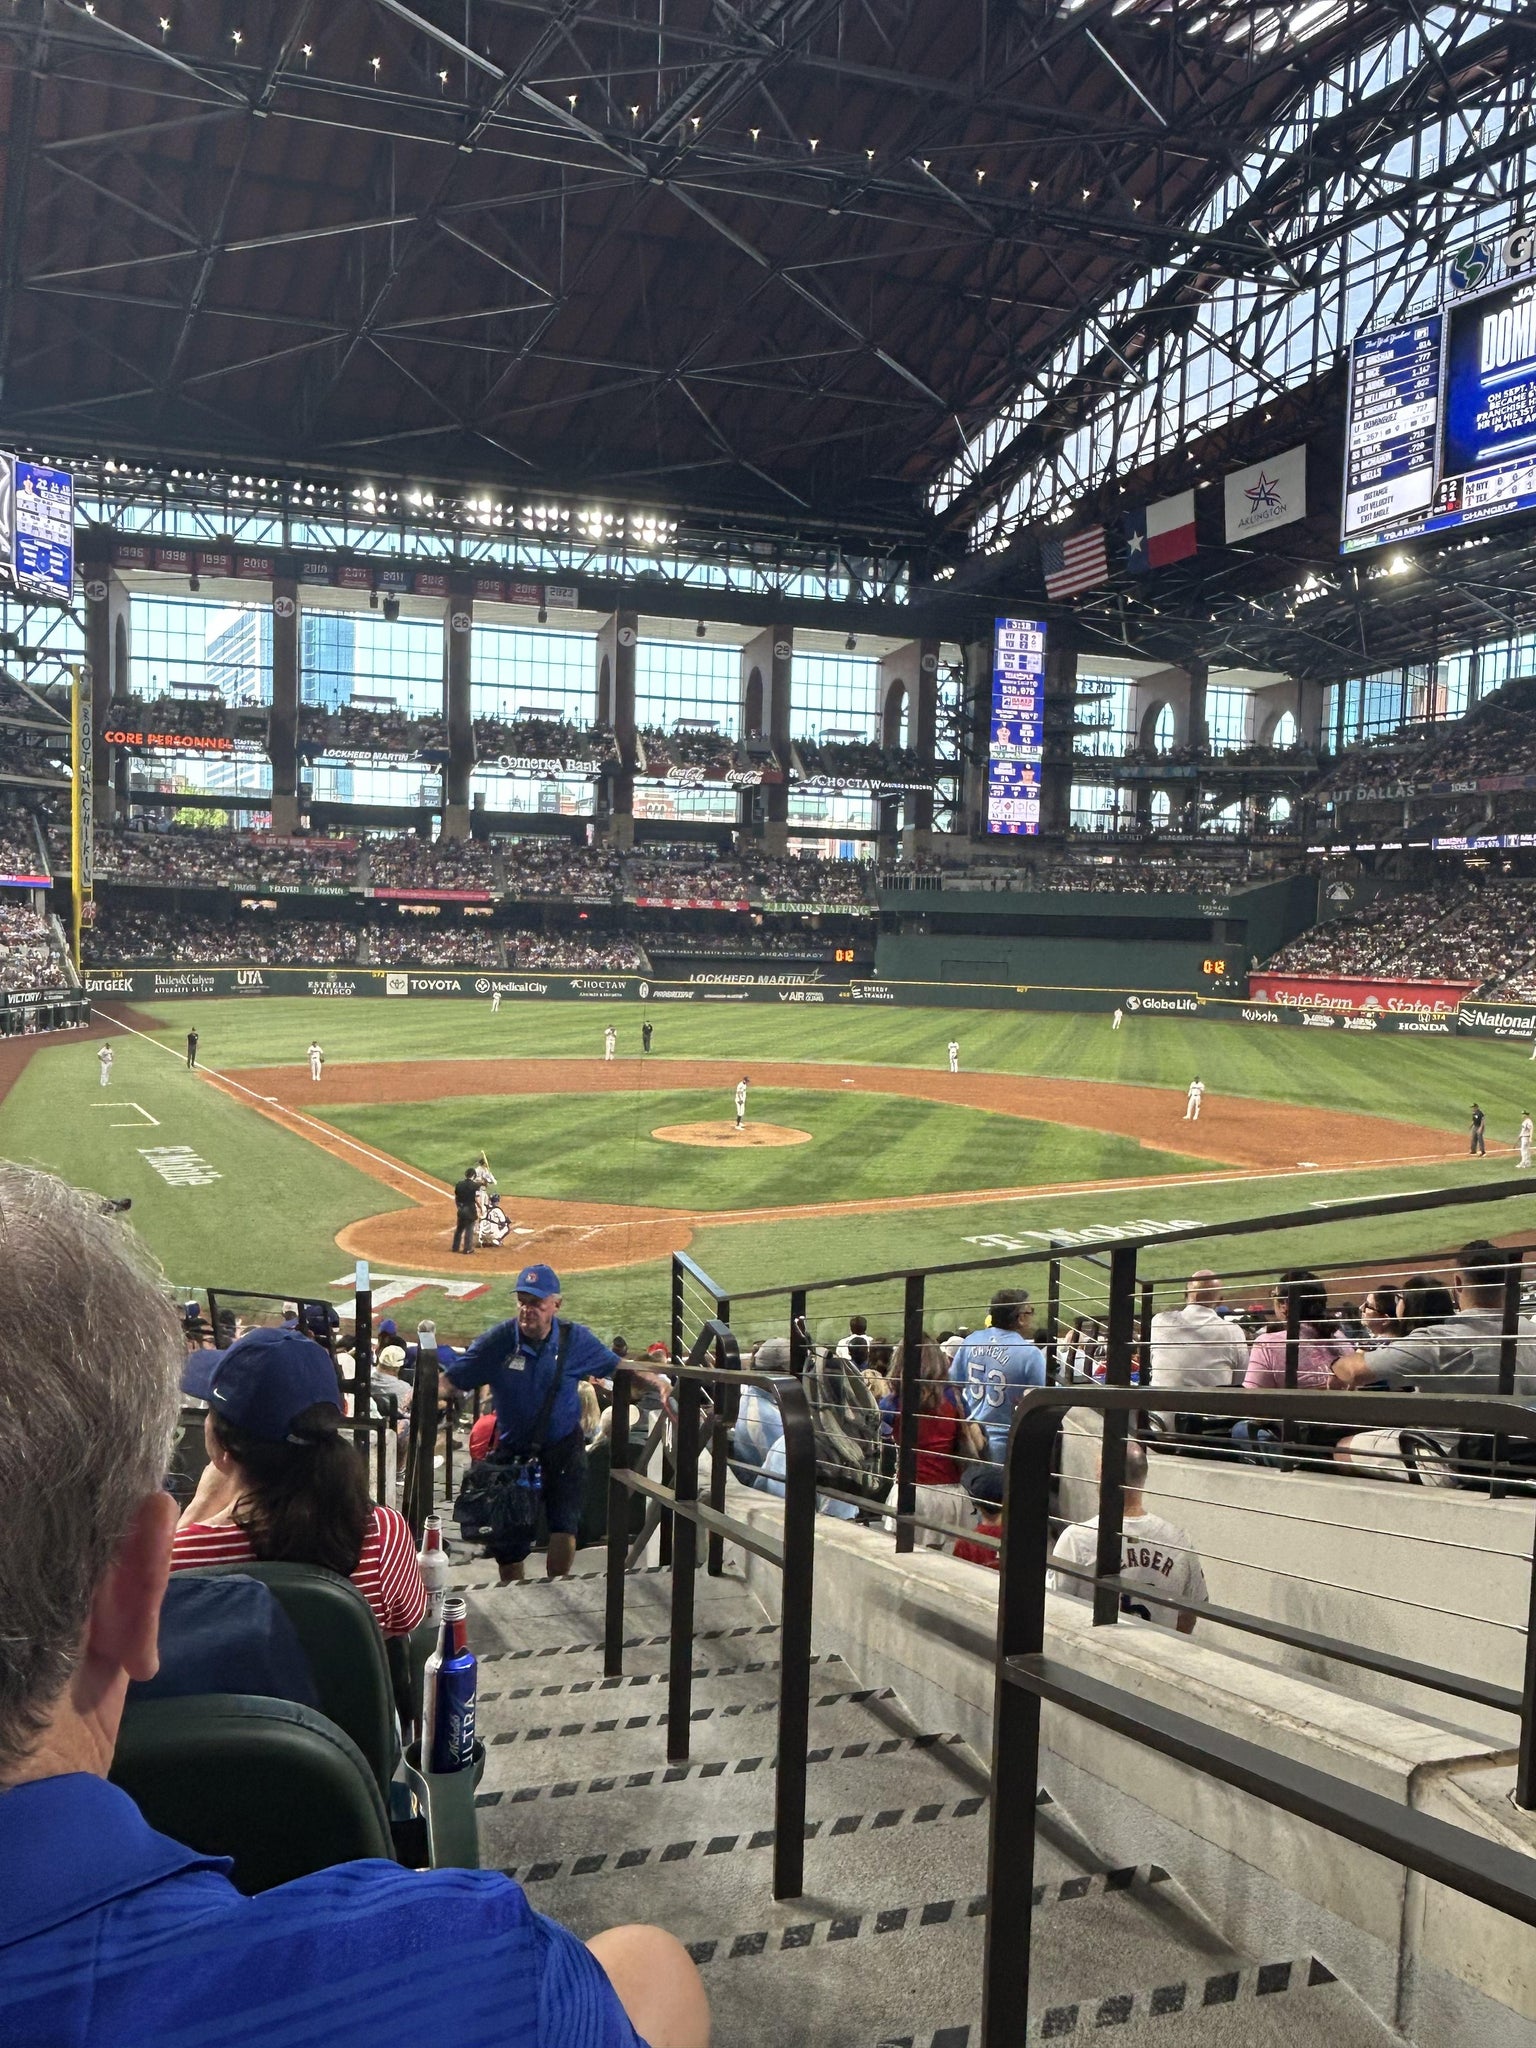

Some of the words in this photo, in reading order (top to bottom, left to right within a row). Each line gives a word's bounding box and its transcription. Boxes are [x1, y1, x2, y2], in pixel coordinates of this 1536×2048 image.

[1487, 392, 1501, 403] ON
[1476, 402, 1526, 422] FRANCHISE
[1494, 418, 1523, 433] PLATE
[1449, 481, 1457, 491] 2
[1462, 501, 1518, 521] CHANGEUP
[276, 602, 292, 614] 34
[623, 631, 631, 642] 7
[105, 731, 143, 745] CORE
[148, 733, 233, 750] PERSONNEL
[323, 748, 371, 759] LOCKHEED
[373, 751, 408, 761] MARTIN
[566, 758, 601, 773] Bank
[817, 775, 881, 790] CHOCTAW
[1332, 789, 1351, 801] UT
[1356, 785, 1415, 801] DALLAS
[774, 902, 812, 913] LUXOR
[815, 903, 868, 916] STAFFING
[238, 970, 263, 985] UTA
[575, 979, 626, 989] CHOCTAW
[690, 973, 755, 984] LOCKHEED
[758, 975, 805, 985] MARTIN
[85, 978, 133, 992] EATGEEK
[308, 981, 356, 990] ESTRELLA
[312, 988, 351, 996] JALISCO
[411, 980, 461, 990] TOYOTA
[8, 992, 40, 1004] VICTORY
[1142, 998, 1175, 1010] Globe
[1176, 998, 1197, 1010] Life
[1275, 991, 1312, 1005] State
[1314, 993, 1352, 1009] Farm
[1242, 1008, 1278, 1022] Kubota
[1398, 1022, 1449, 1032] HONDA
[966, 1361, 1007, 1407] 53
[1120, 1547, 1174, 1578] AGER
